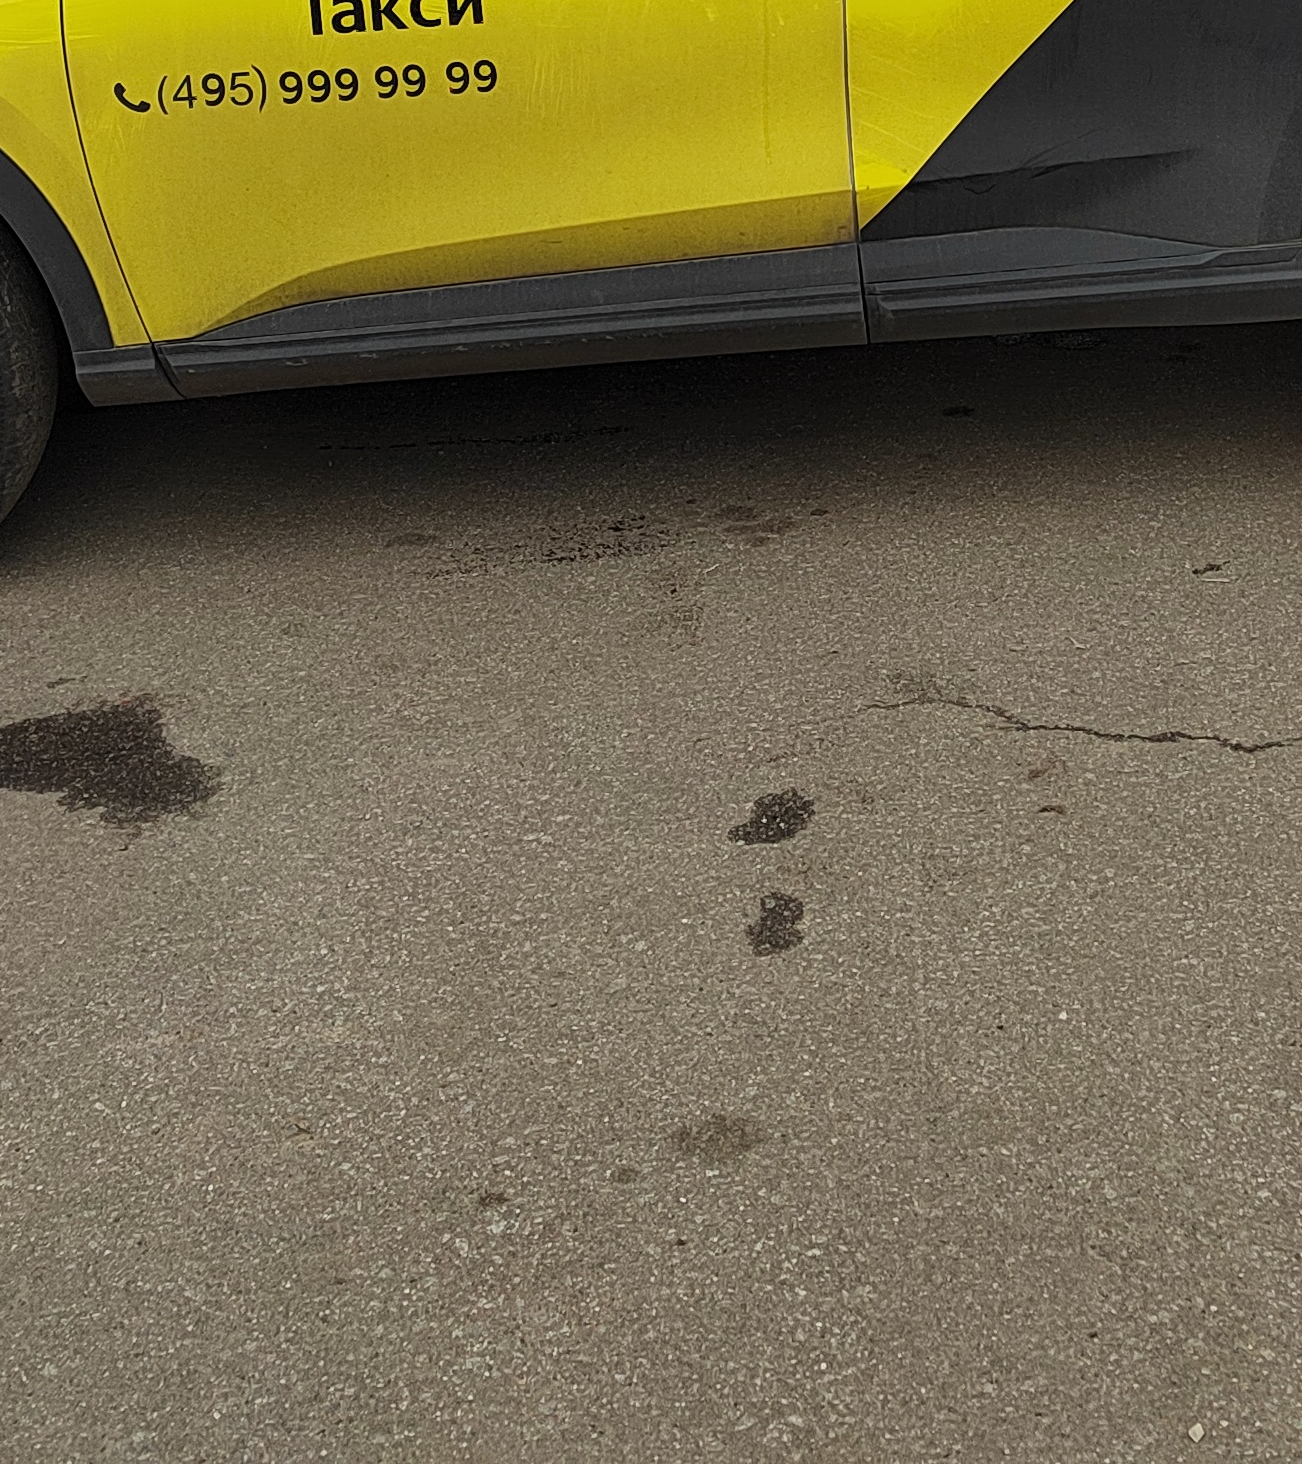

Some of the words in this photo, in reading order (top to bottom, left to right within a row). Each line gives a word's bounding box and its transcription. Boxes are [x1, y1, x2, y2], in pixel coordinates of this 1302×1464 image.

[156, 64, 268, 115] (495)
[278, 67, 359, 105] 999
[374, 63, 427, 100] 99
[444, 59, 499, 95] 99
